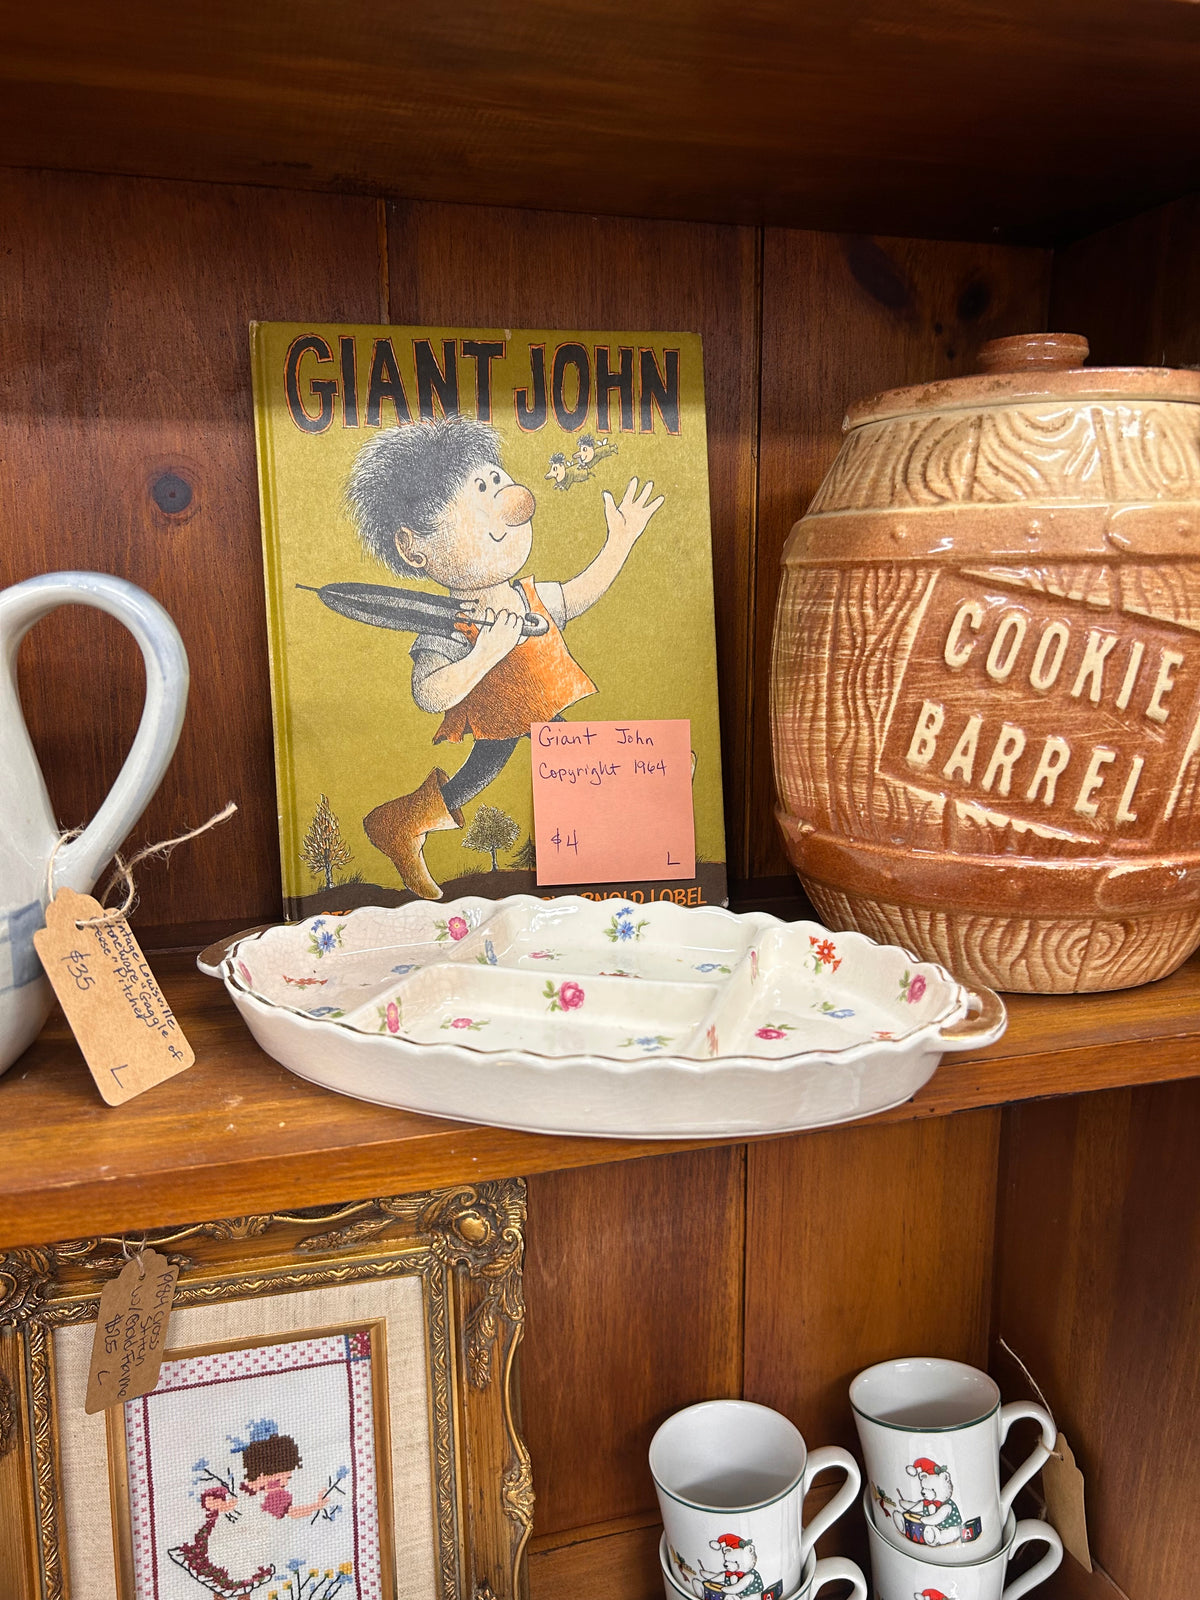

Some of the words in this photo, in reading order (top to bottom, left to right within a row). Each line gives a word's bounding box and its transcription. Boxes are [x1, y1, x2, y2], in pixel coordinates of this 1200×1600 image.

[284, 333, 507, 434] GIANT
[513, 341, 681, 435] JOHN
[944, 600, 1184, 723] COOKIE
[538, 725, 597, 747] Giant
[615, 727, 655, 747] John
[539, 760, 621, 786] Copyright
[634, 759, 667, 777] 1964
[906, 698, 1144, 823] BARREL
[667, 851, 681, 866] L
[61, 950, 96, 990] $35
[114, 912, 140, 962] intage
[138, 963, 176, 1031] Louisville
[112, 966, 147, 1021] Pitcher
[167, 1045, 184, 1062] of
[153, 1270, 175, 1309] 1984
[104, 1312, 125, 1355] $25
